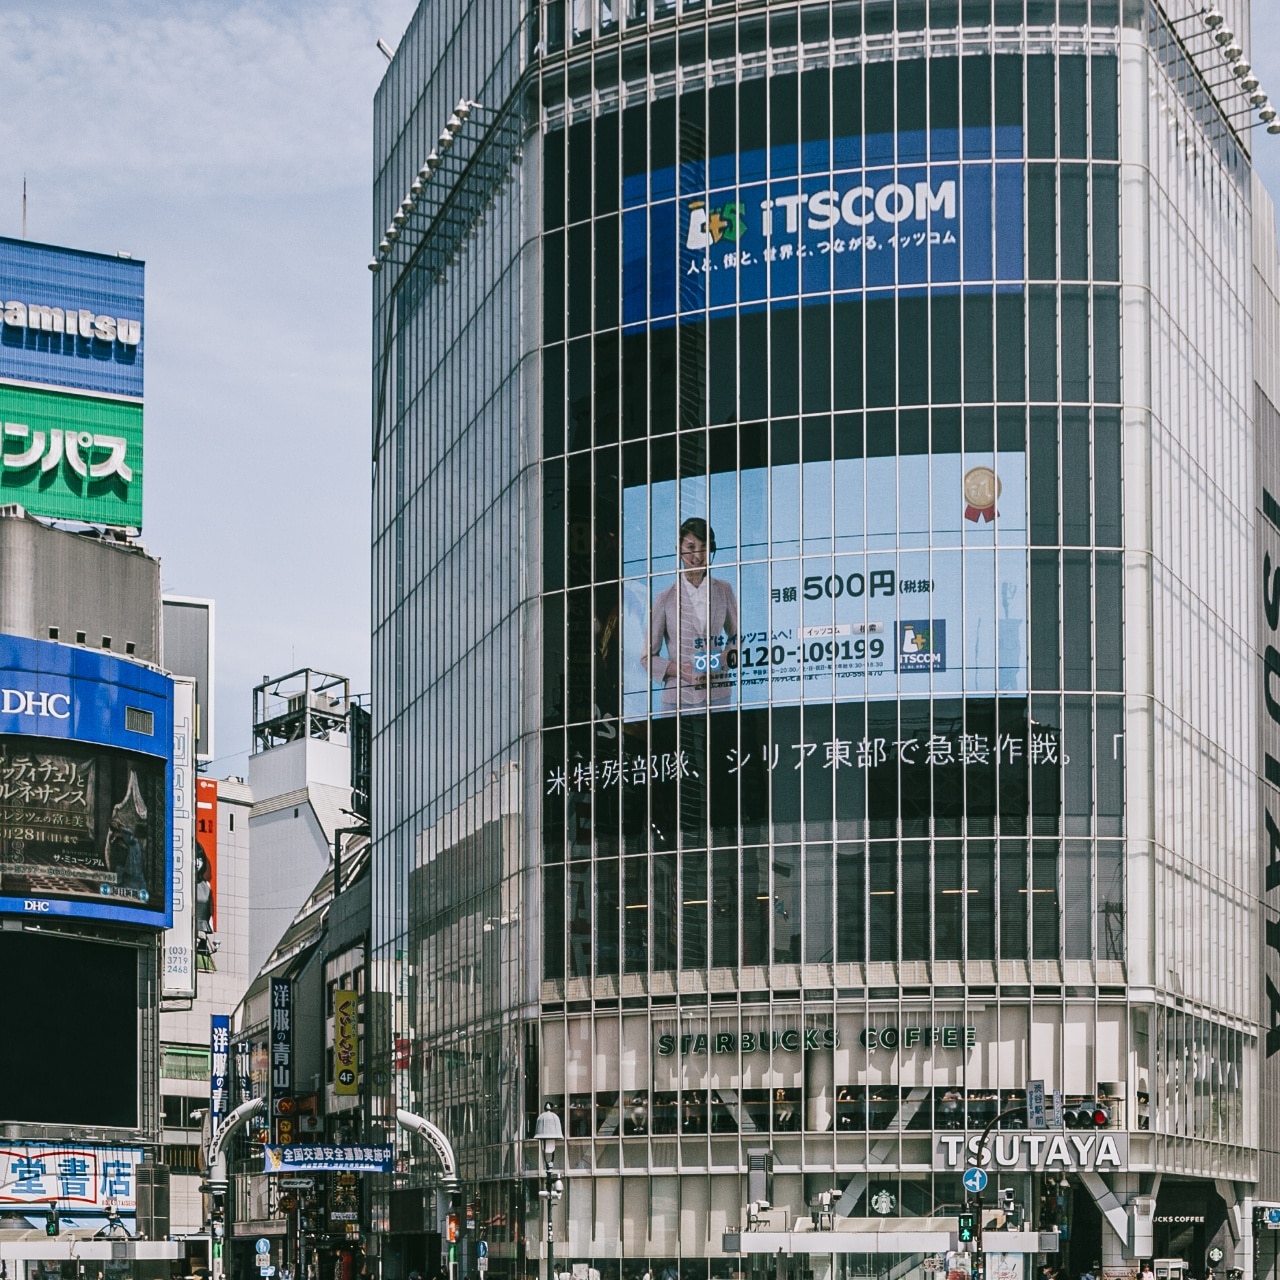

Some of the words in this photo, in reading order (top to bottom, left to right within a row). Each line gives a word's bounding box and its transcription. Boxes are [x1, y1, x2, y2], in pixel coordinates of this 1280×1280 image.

[761, 180, 956, 236] iTSCOM
[726, 638, 884, 670] 0120-109199
[1, 688, 71, 719] DHC
[23, 900, 50, 912] DHC
[167, 955, 188, 965] 3719
[168, 946, 188, 956] (03)
[167, 964, 188, 974] 2468
[273, 984, 291, 1089] 洋服の青山
[658, 1028, 841, 1057] STARBUCKS
[859, 1026, 977, 1052] COFFEE
[340, 1073, 353, 1082] 4F
[1033, 1083, 1044, 1127] 渋谷駅前
[283, 1147, 391, 1162] 全国交通安全運動実施中
[941, 1135, 1122, 1167] TSUTAYA
